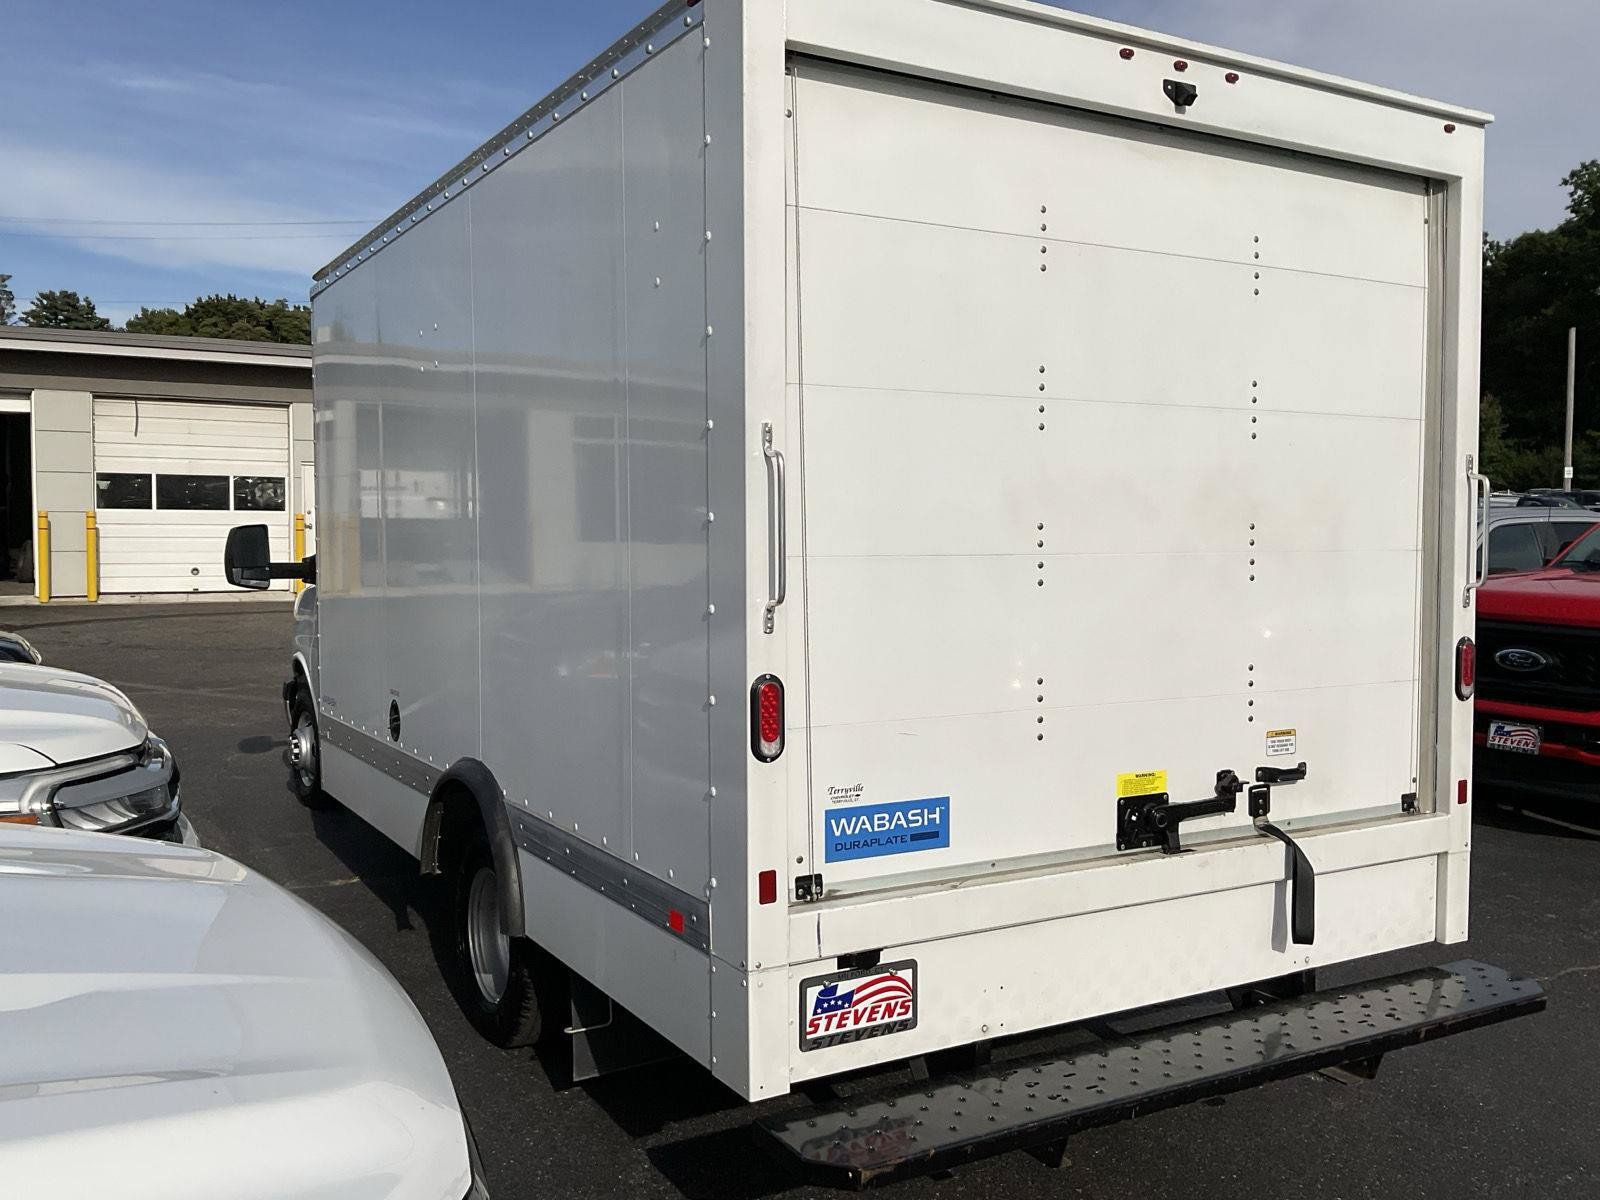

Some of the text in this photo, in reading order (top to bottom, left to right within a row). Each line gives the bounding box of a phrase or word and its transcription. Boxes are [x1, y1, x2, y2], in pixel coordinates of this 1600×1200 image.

[1489, 736, 1537, 749] STEVENS
[828, 783, 864, 795] Terryville
[834, 834, 908, 852] DURAPLATE
[806, 998, 913, 1036] STEVENS
[809, 1018, 914, 1051] STEVENS
